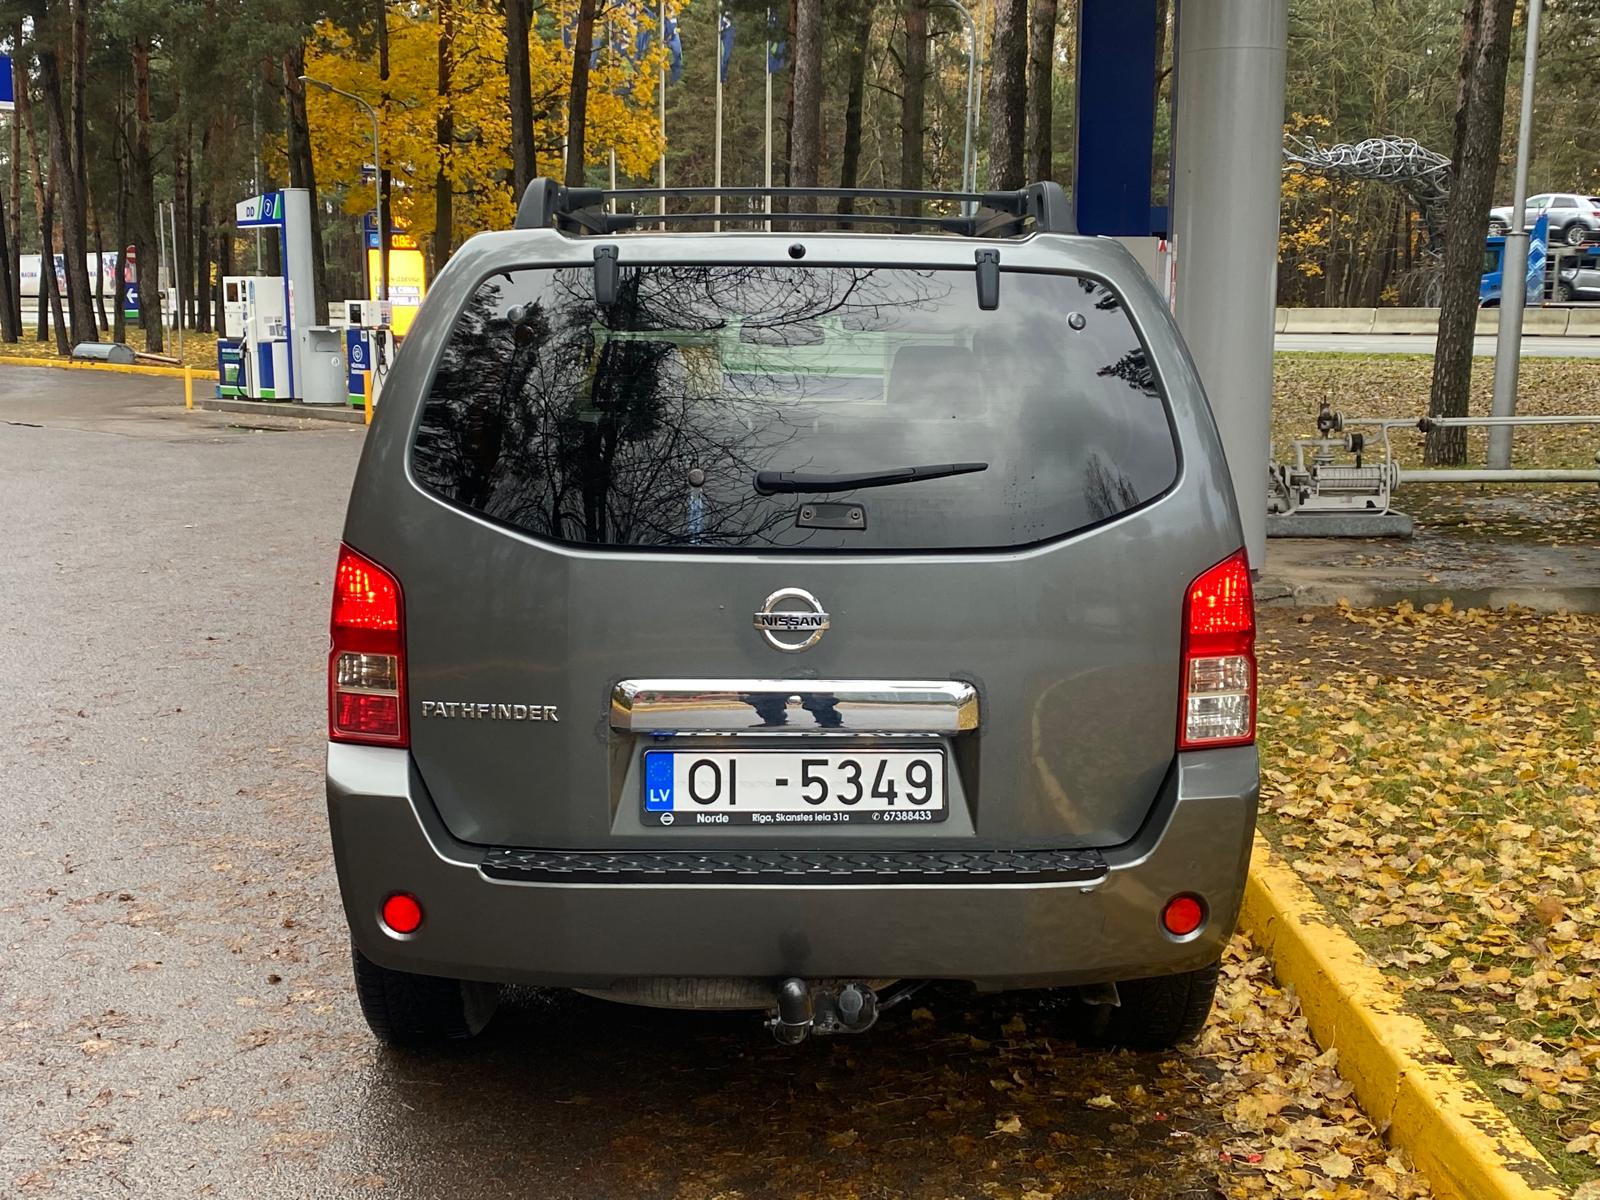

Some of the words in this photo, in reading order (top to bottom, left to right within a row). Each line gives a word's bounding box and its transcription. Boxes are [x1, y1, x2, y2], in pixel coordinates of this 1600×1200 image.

[246, 206, 255, 218] DD
[761, 616, 822, 626] NISSAN
[421, 701, 560, 722] PATHFINDER
[649, 789, 671, 802] LV
[696, 813, 730, 824] Norde
[775, 812, 813, 823] Skanstes
[814, 812, 832, 822] iela
[832, 812, 850, 822] 31a
[883, 810, 932, 822] 67388433
